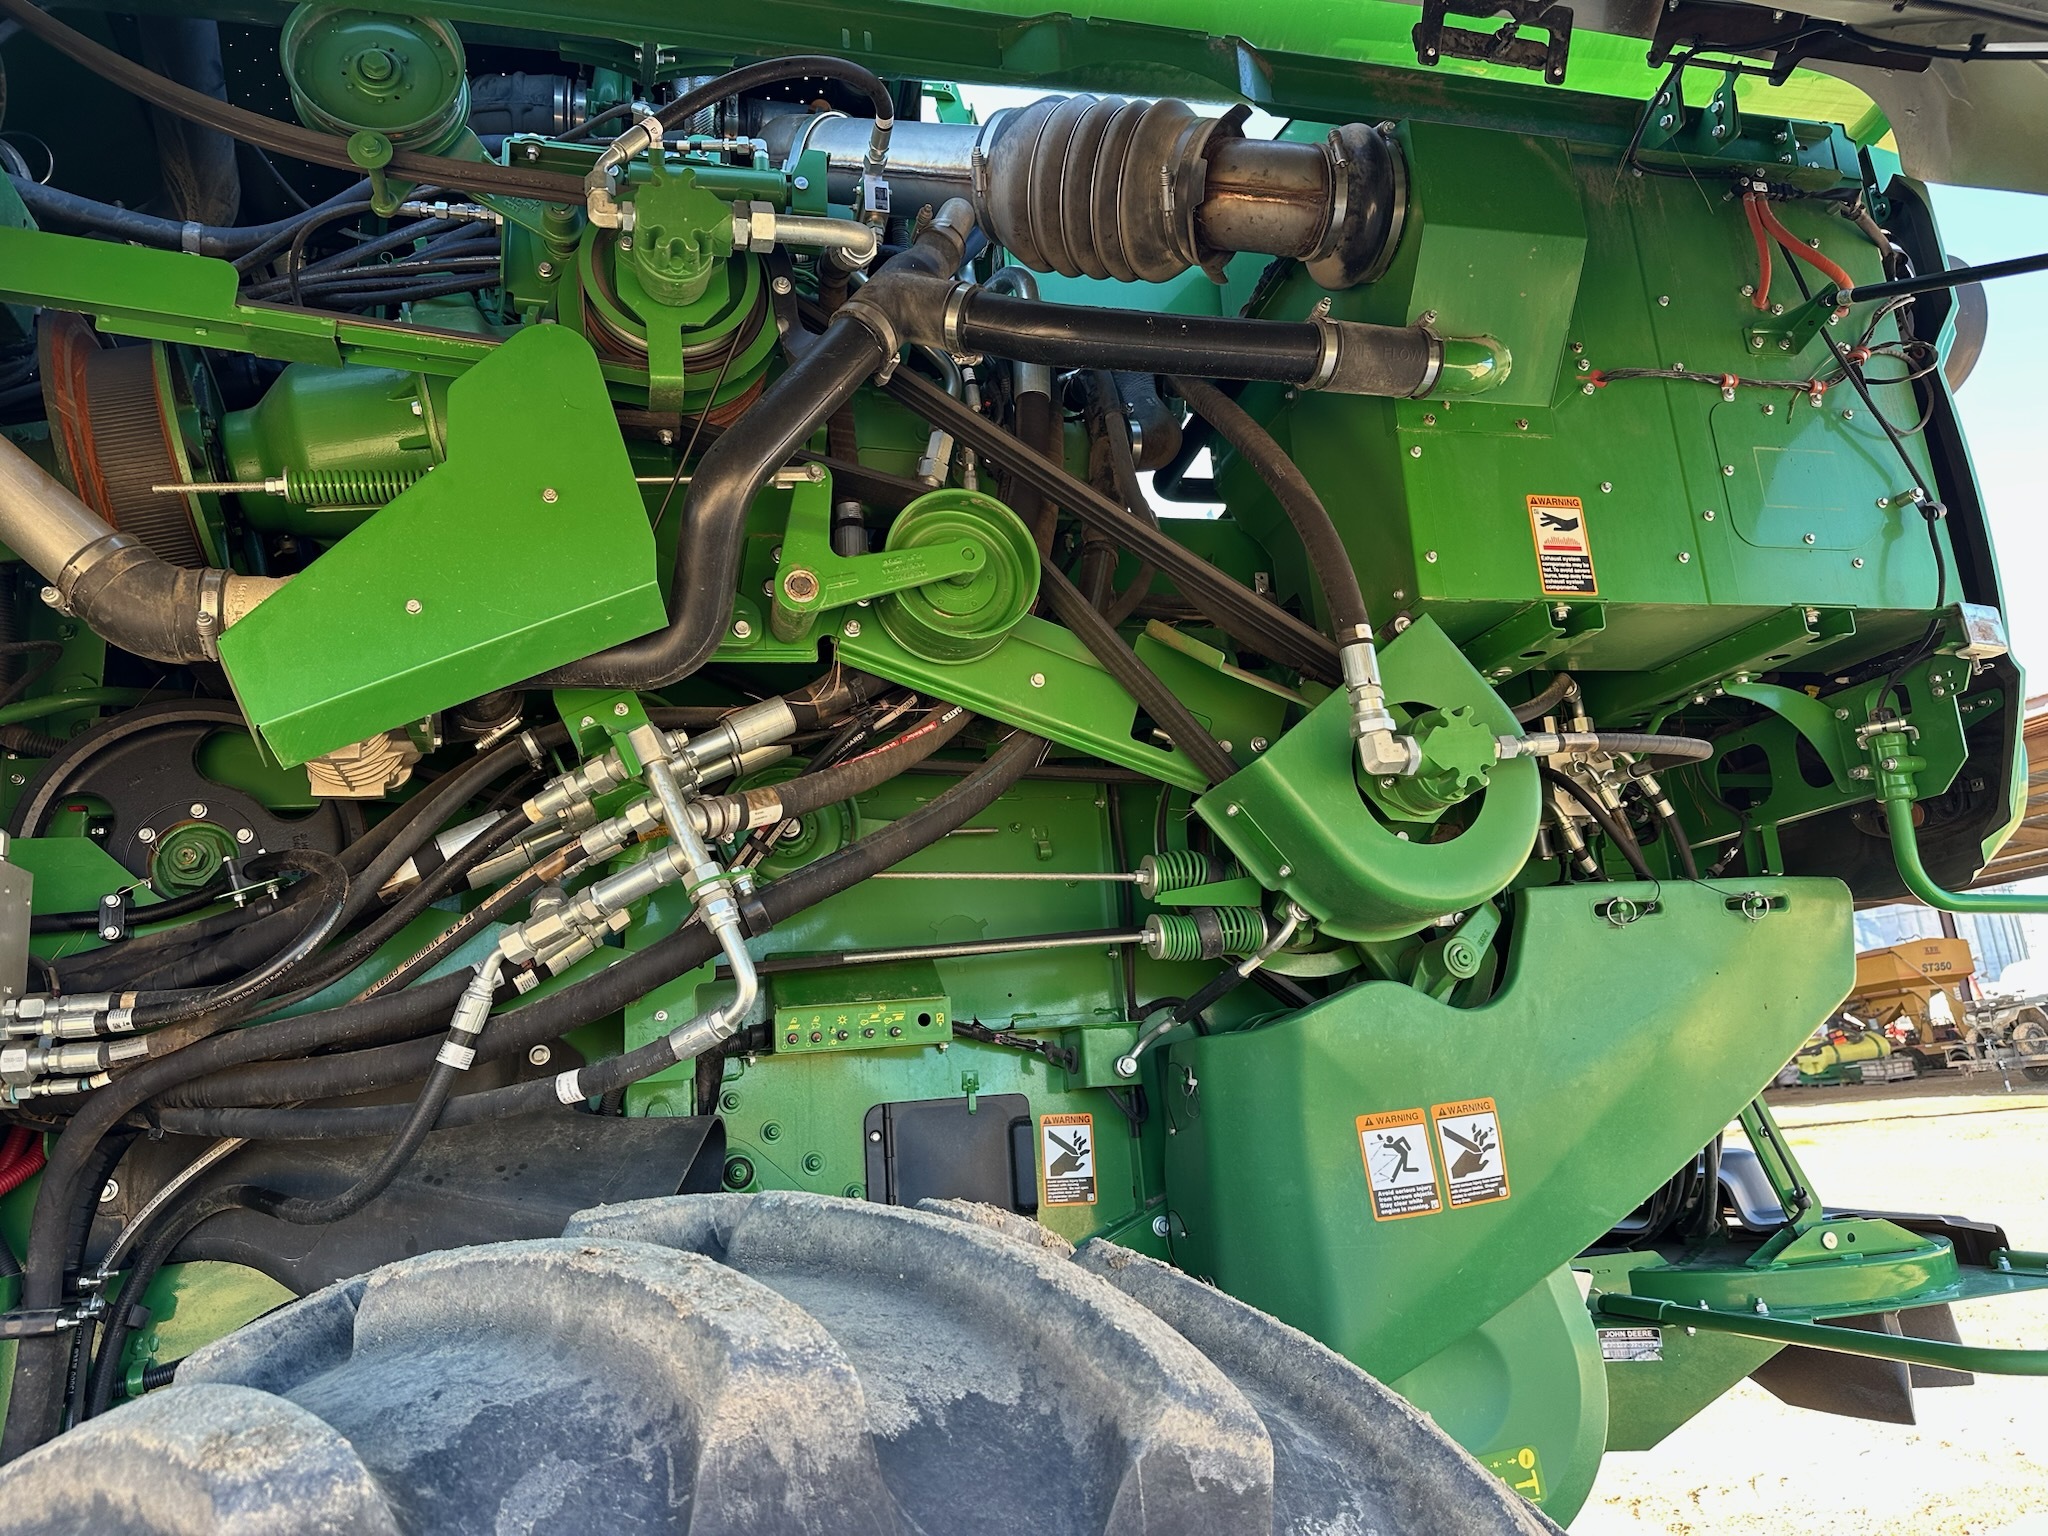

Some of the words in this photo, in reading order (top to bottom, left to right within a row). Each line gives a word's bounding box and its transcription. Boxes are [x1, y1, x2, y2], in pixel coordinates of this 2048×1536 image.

[1349, 344, 1372, 355] AIR
[1384, 347, 1424, 362] FLOW
[1538, 497, 1579, 506] WARNING
[940, 705, 964, 723] GATES
[1922, 961, 1952, 972] ST350
[1448, 1102, 1490, 1115] WARNING
[1052, 1115, 1090, 1124] WARNING
[1376, 1113, 1418, 1125] WARNING
[1395, 1187, 1416, 1195] serious
[1416, 1184, 1432, 1192] injury
[1381, 1208, 1400, 1216] engine
[1407, 1203, 1430, 1212] running.
